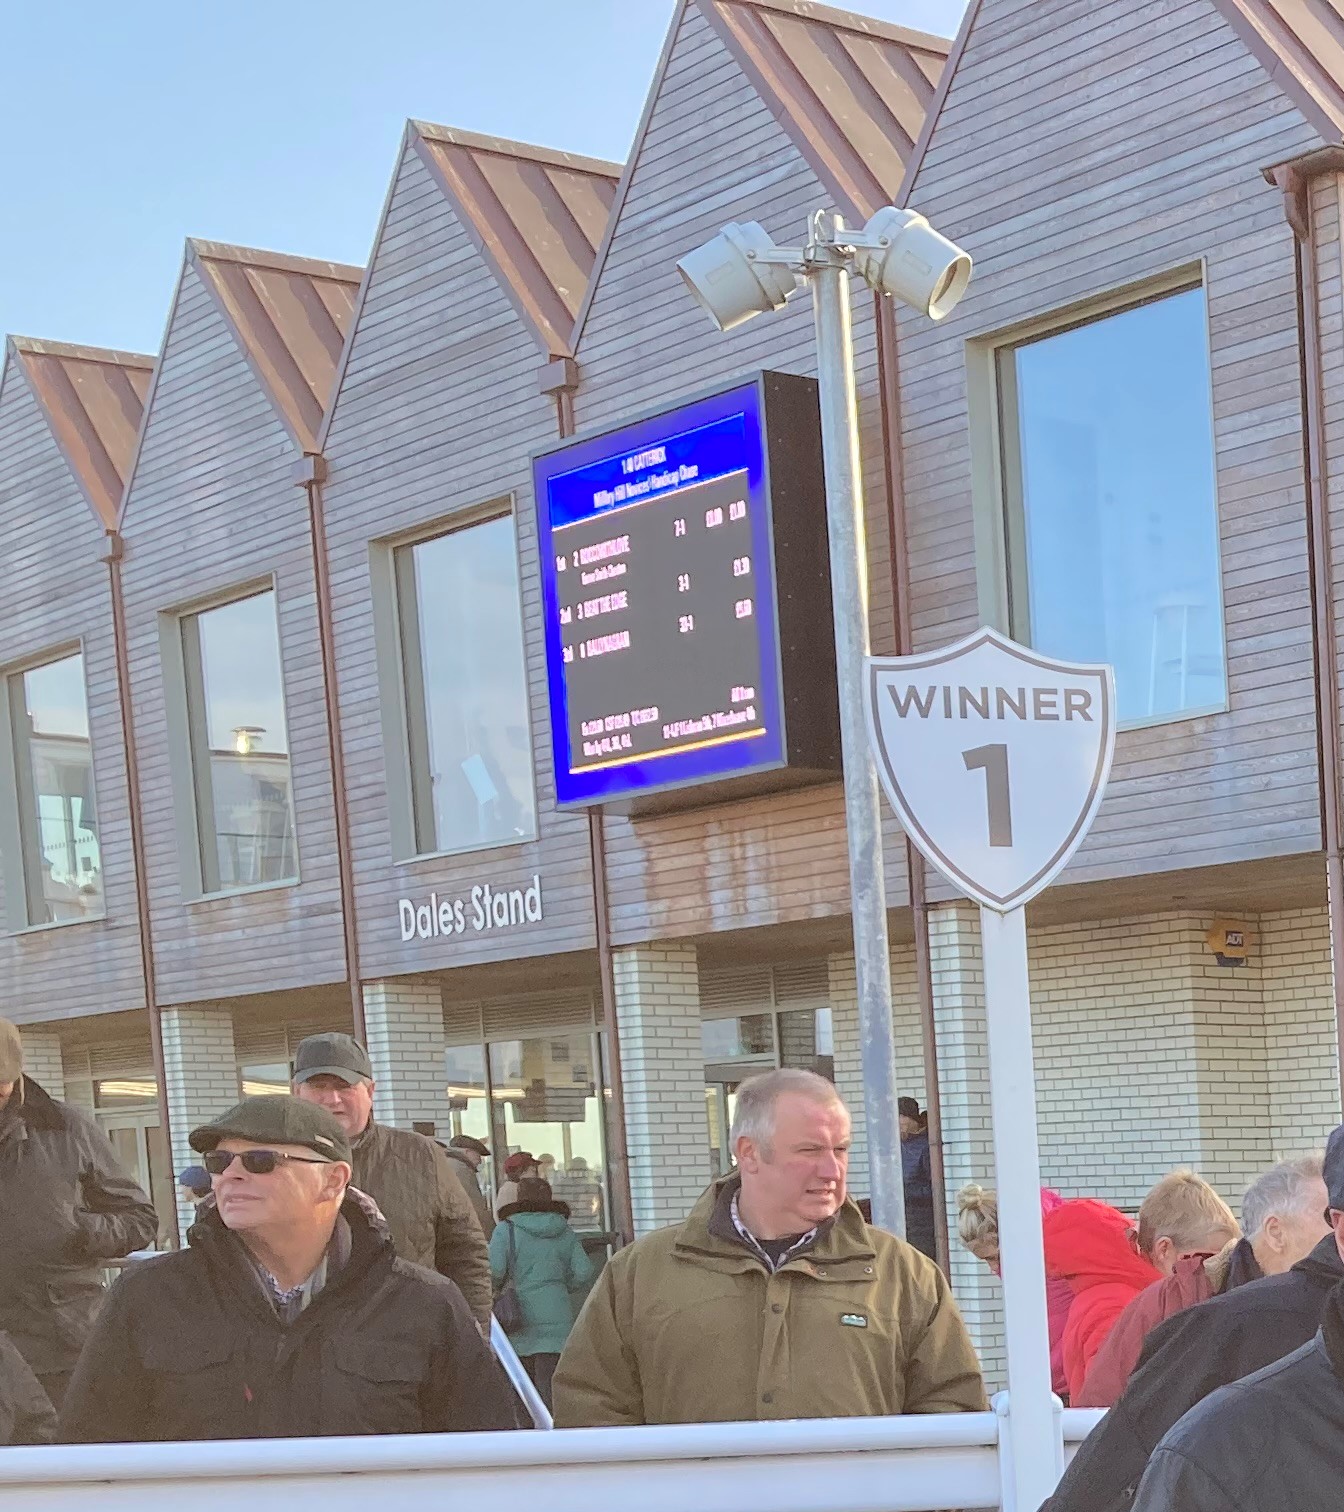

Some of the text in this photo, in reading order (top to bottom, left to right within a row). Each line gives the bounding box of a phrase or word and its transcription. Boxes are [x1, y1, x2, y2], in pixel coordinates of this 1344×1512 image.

[651, 469, 679, 490] Handicap
[679, 464, 698, 481] Chase
[886, 684, 1094, 721] WINNER
[961, 743, 1012, 847] 1
[399, 874, 543, 942] Dales Stand
